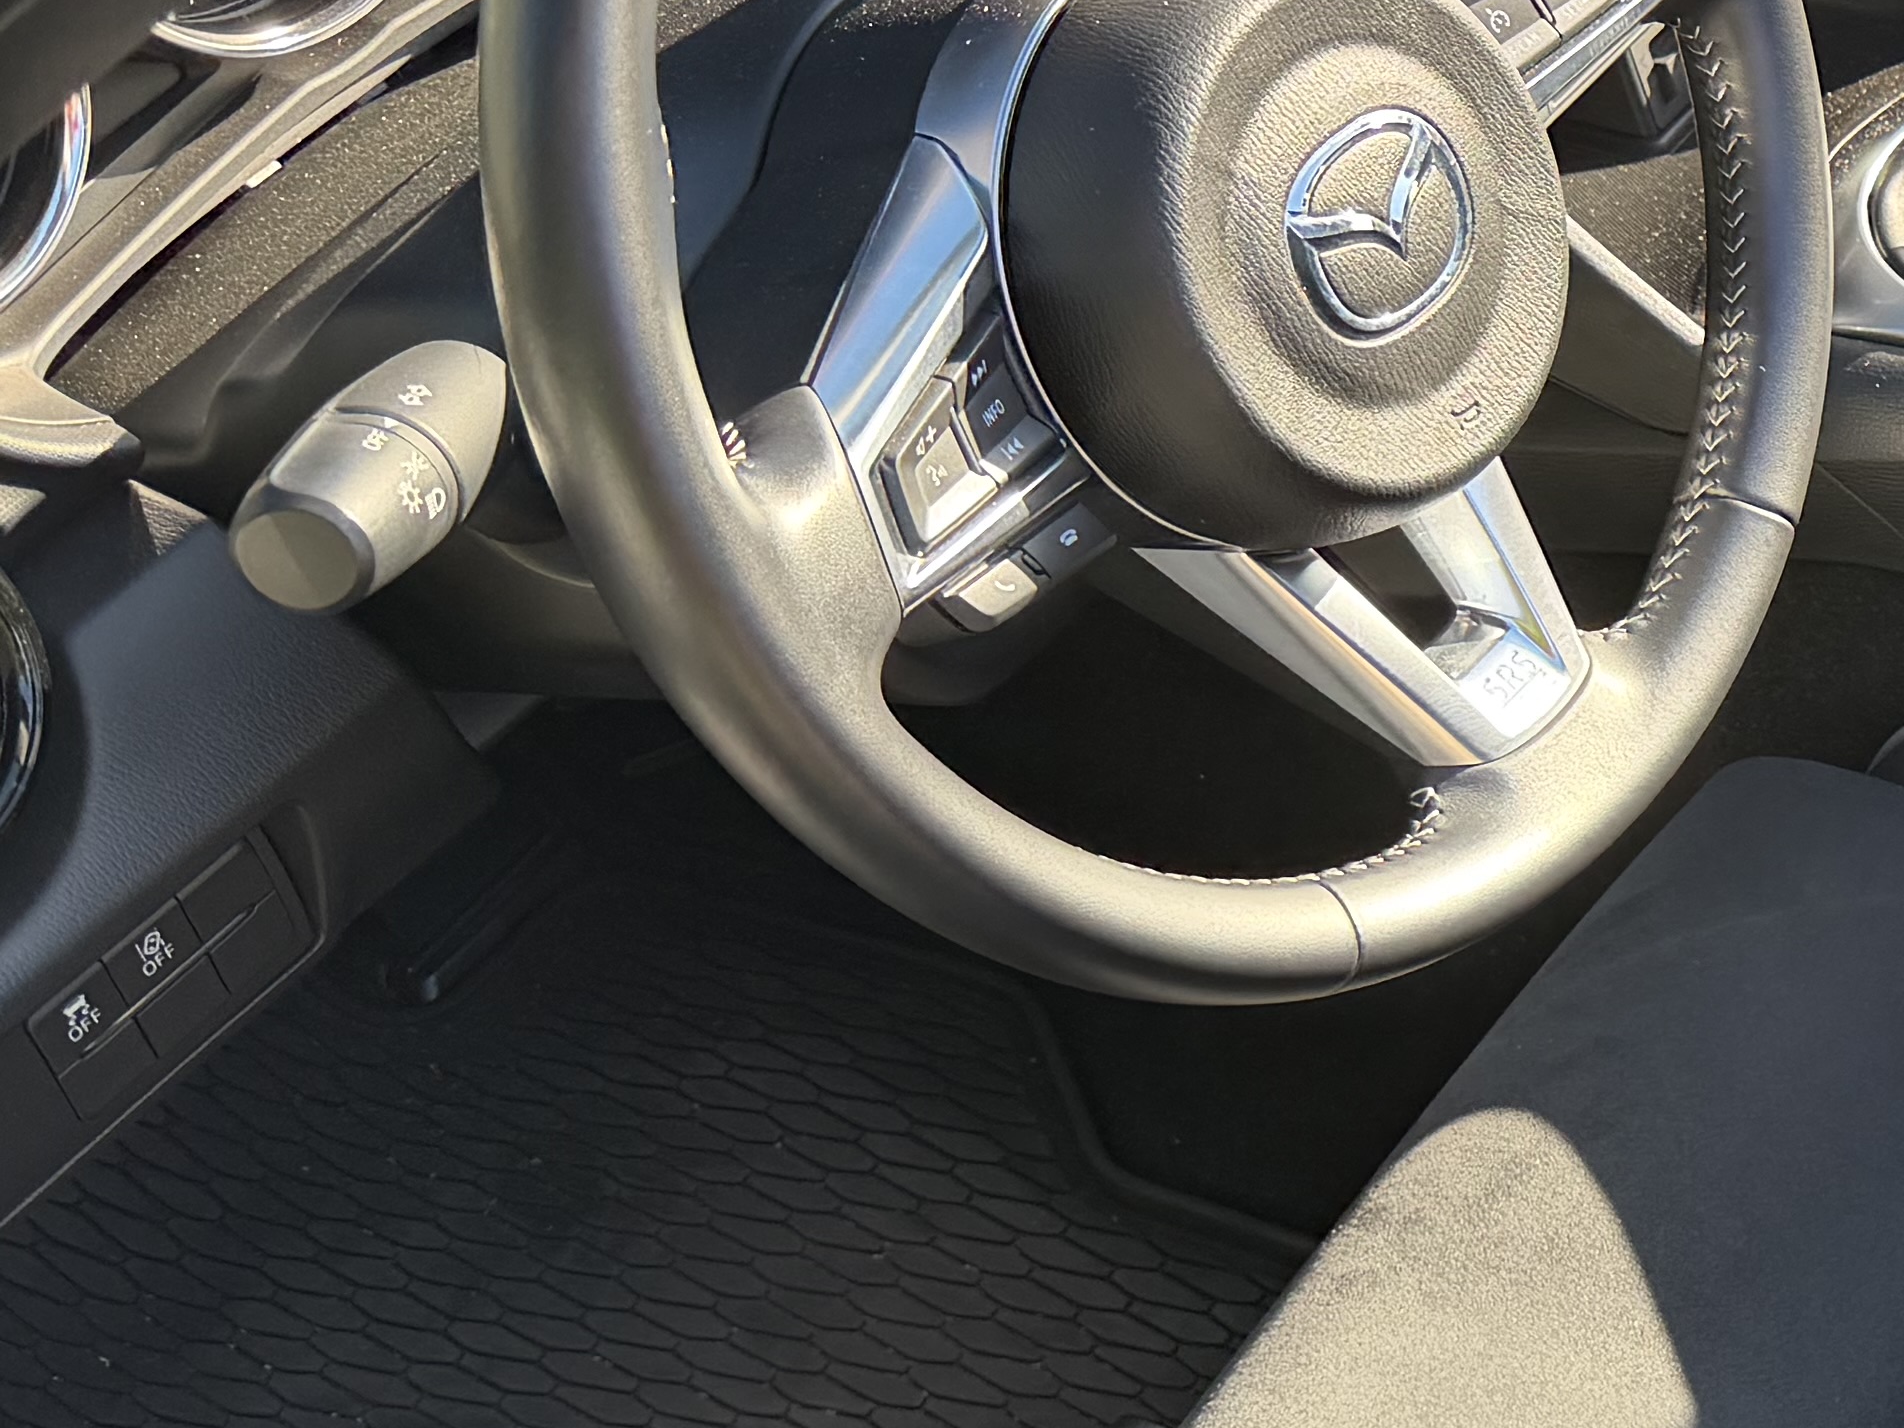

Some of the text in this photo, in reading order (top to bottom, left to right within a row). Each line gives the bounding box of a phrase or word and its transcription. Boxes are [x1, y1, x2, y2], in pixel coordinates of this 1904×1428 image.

[982, 399, 1005, 428] INFO
[143, 943, 175, 977] OFF
[68, 1007, 101, 1043] OFF
